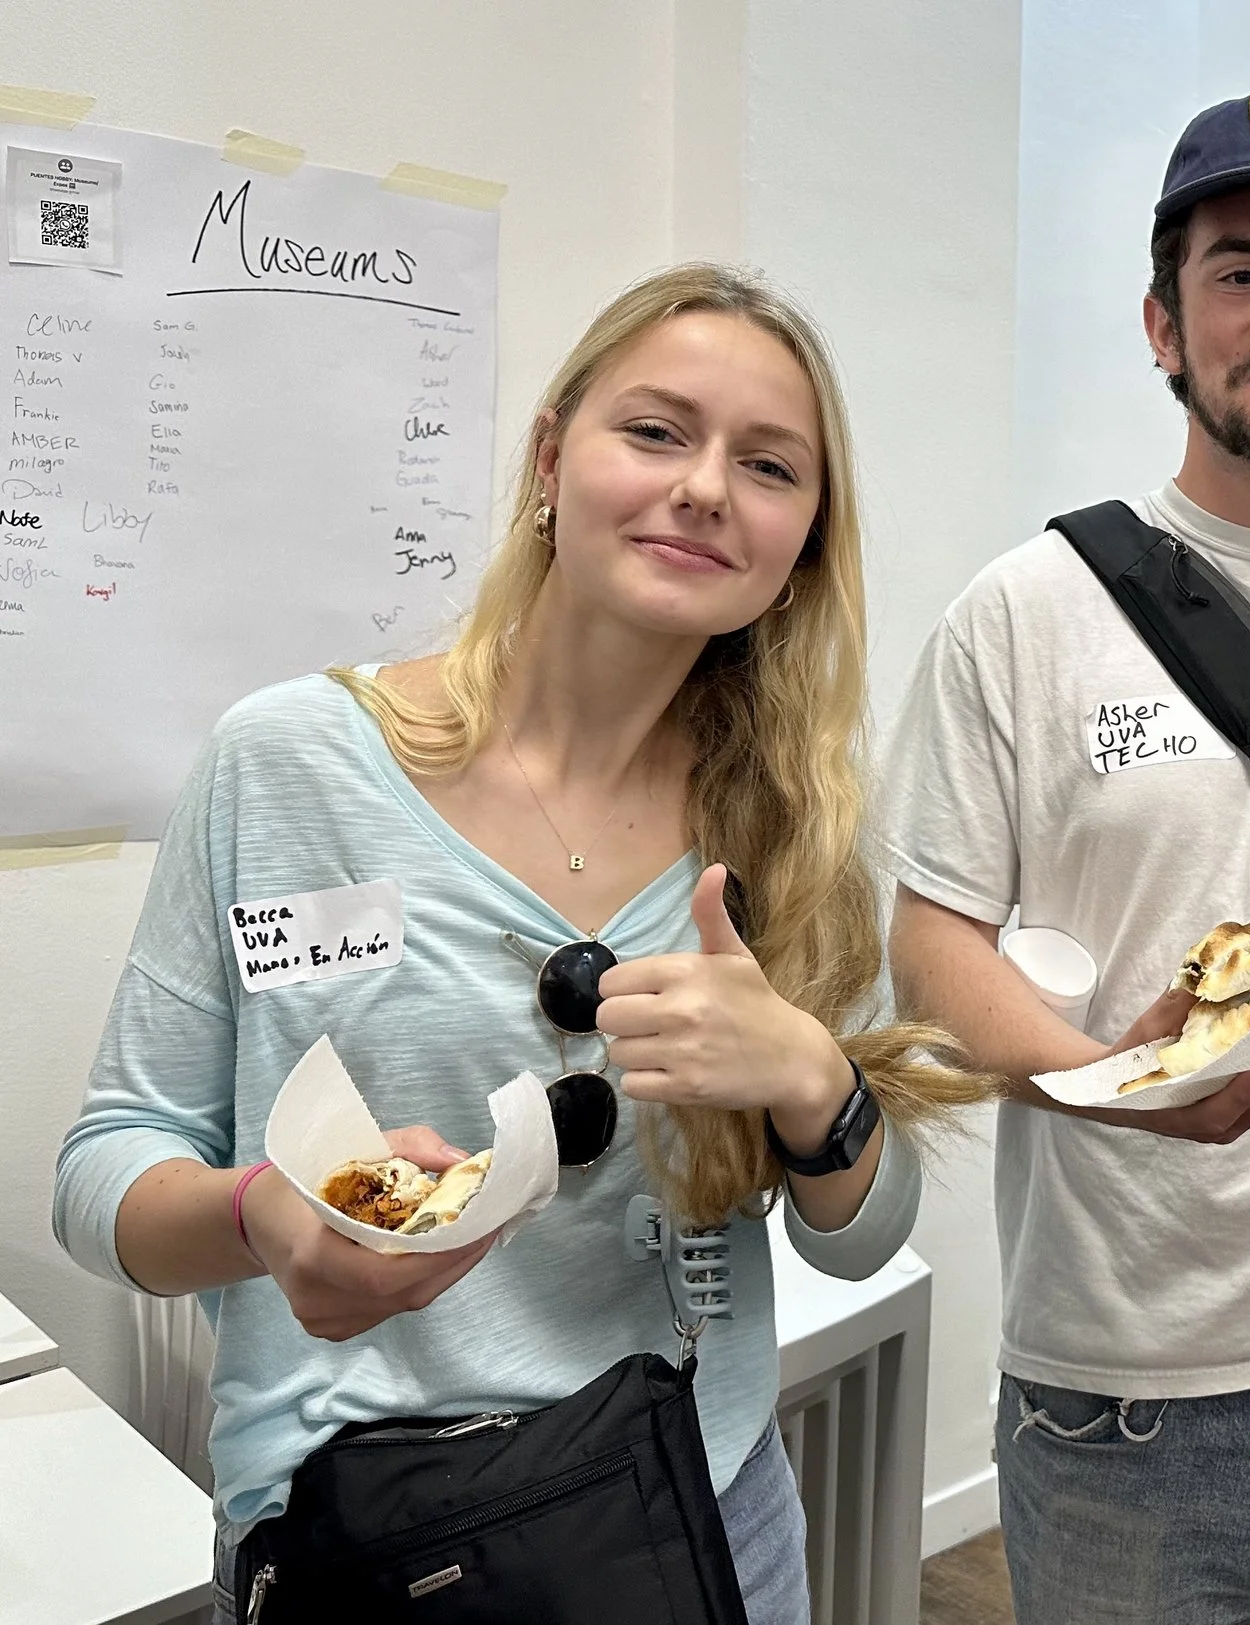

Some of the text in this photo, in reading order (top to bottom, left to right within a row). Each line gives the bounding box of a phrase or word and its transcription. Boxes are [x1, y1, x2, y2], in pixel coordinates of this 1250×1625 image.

[191, 179, 417, 284] Museums
[12, 431, 80, 450] AMBER
[83, 501, 153, 543] Libby
[394, 549, 457, 580] Jenny
[1098, 703, 1170, 727] Asher
[1098, 721, 1147, 748] UVA
[570, 855, 585, 870] B
[233, 907, 294, 928] Becca
[242, 927, 288, 950] UVA
[310, 945, 331, 966] En
[338, 933, 389, 961] Acción
